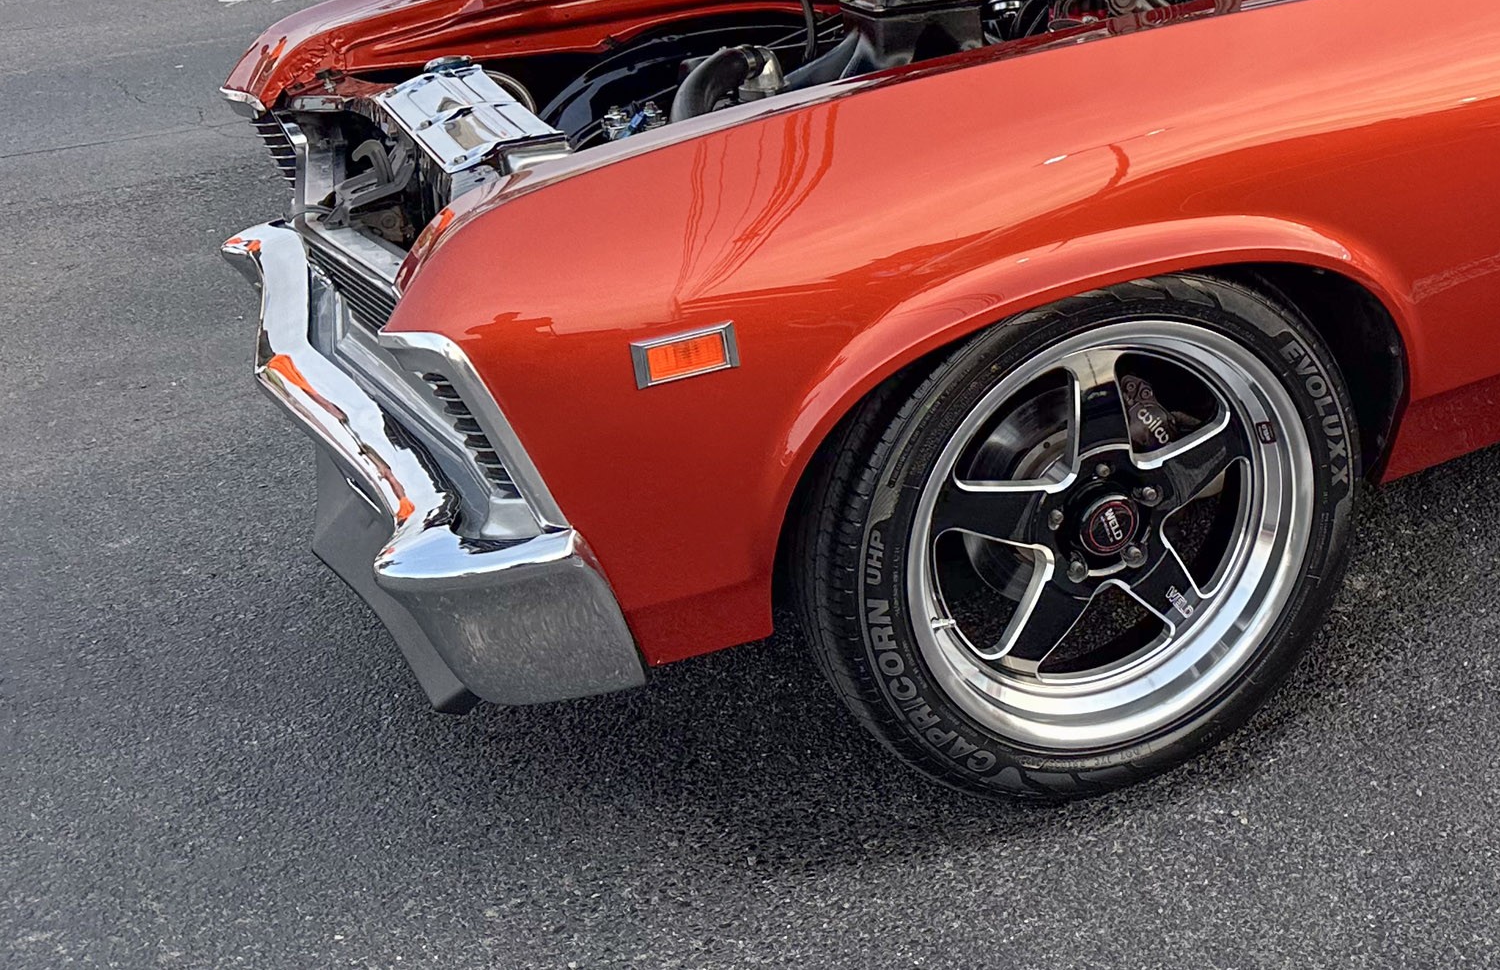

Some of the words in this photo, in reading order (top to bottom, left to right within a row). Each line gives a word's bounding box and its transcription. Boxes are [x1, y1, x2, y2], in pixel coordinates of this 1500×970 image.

[1137, 408, 1170, 444] wilw
[1279, 340, 1348, 487] EVOLUXX
[1104, 508, 1123, 541] WELD
[867, 530, 885, 586] UHP
[1165, 585, 1194, 619] WELD
[866, 598, 997, 772] CAPRICORN
